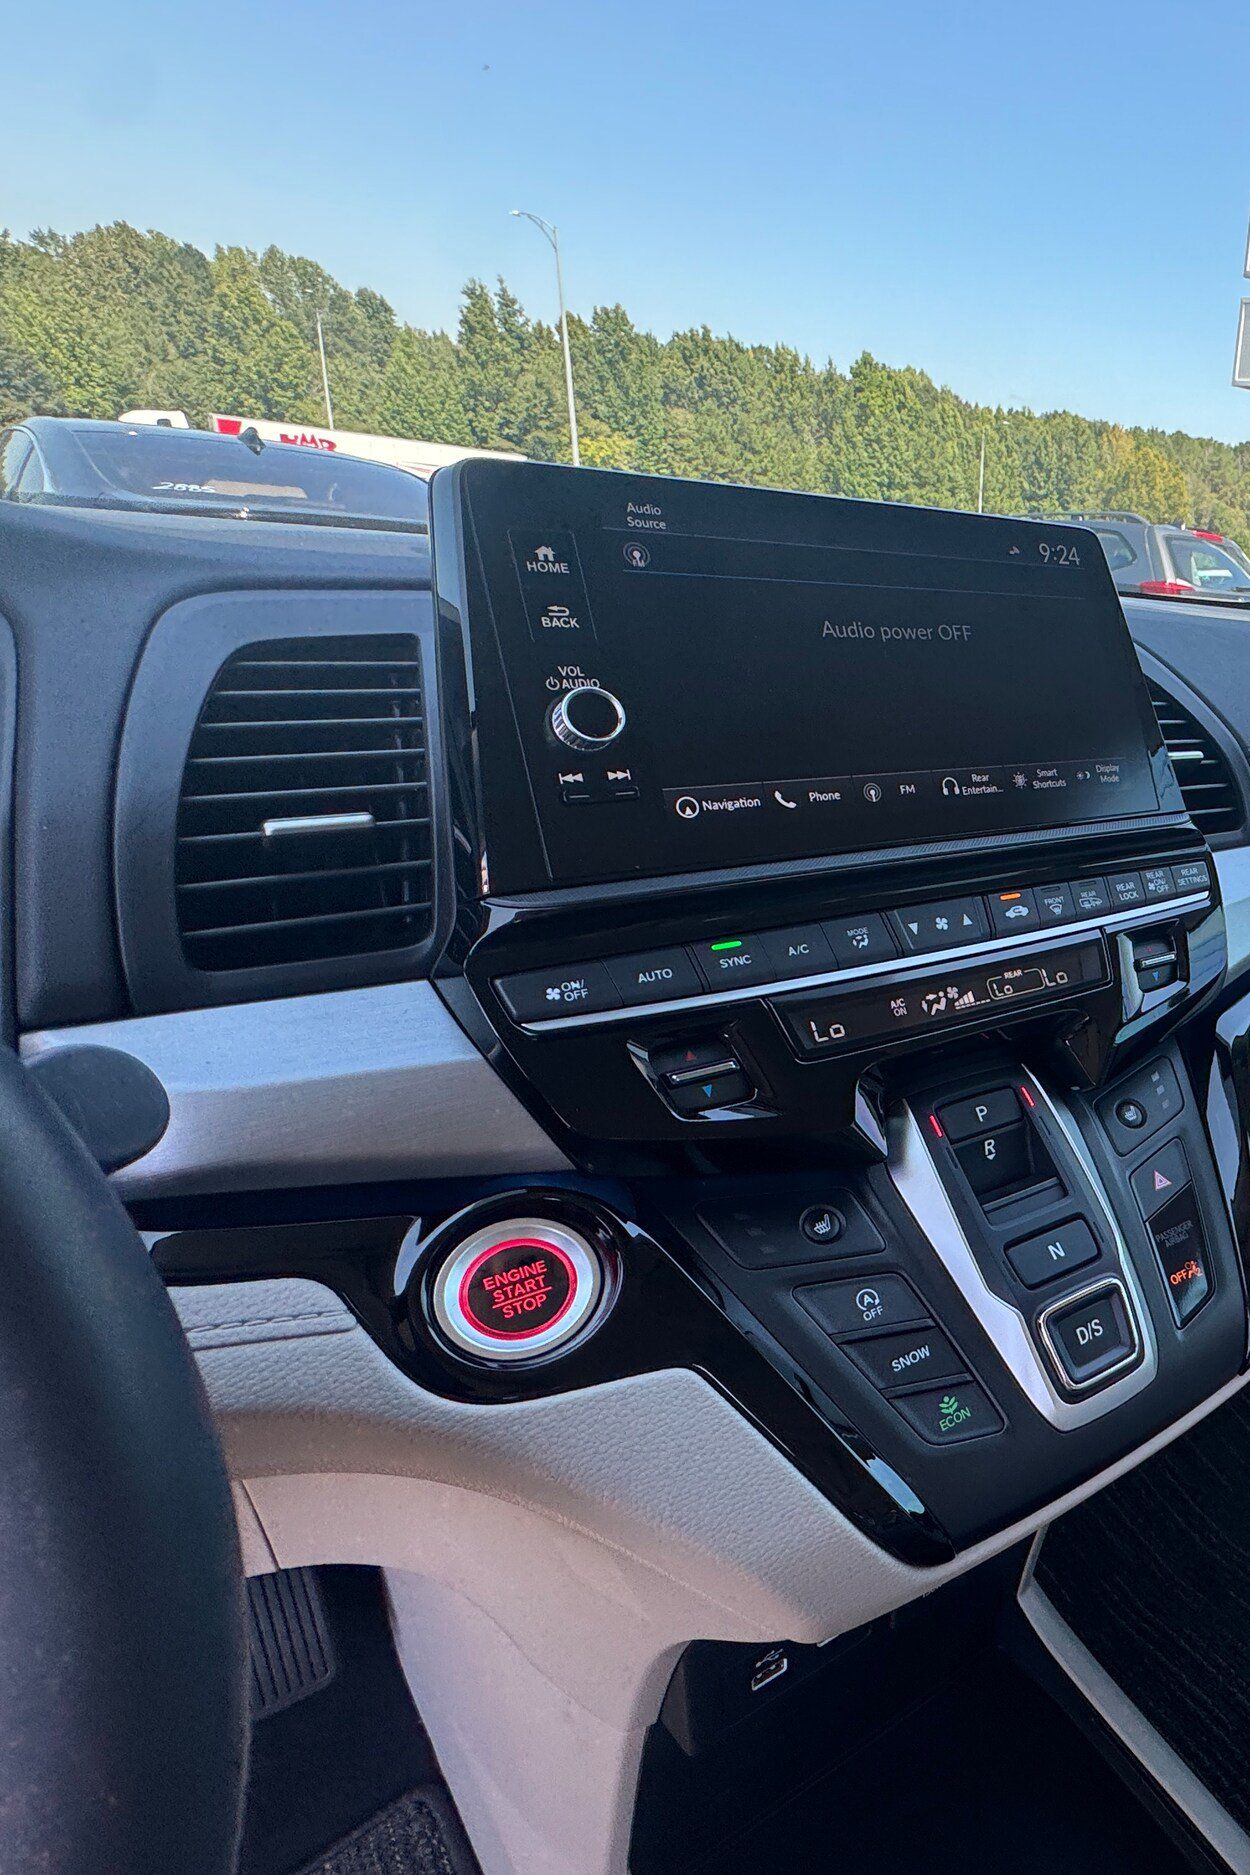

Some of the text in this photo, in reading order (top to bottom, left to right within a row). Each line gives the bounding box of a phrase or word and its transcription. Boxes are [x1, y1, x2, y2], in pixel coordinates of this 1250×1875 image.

[627, 502, 662, 516] Audio
[627, 516, 667, 530] Source
[1038, 543, 1081, 565] 9:24
[526, 561, 570, 574] HOME
[541, 616, 580, 628] BACK
[822, 620, 972, 642] Audio power OFF
[558, 665, 585, 677] VOL
[562, 678, 601, 690] AUDIO
[1036, 768, 1058, 777] Smart
[1095, 764, 1119, 774] Display
[971, 773, 990, 782] Rear
[1032, 779, 1067, 789] Shortcuts
[1100, 774, 1120, 783] Mode
[899, 784, 916, 795] FM
[808, 791, 841, 802] Phone
[702, 797, 762, 812] Navigation
[1146, 870, 1164, 880] REAR
[1180, 867, 1199, 876] REAR
[1116, 881, 1135, 892] REAR
[1178, 875, 1208, 887] SETTINGS
[1080, 890, 1097, 898] REAR
[1157, 885, 1169, 893] OFF
[1044, 896, 1065, 906] FRONT
[1120, 891, 1139, 901] LOCK
[846, 926, 869, 937] MODE
[788, 943, 810, 957] A/C
[719, 954, 752, 969] SYNC
[637, 968, 673, 984] AUTO
[1003, 969, 1023, 980] REAR
[1041, 968, 1068, 987] Lo
[564, 988, 589, 1002] OFF
[890, 998, 906, 1009] A/C
[893, 1007, 908, 1017] ON
[810, 1020, 846, 1044] Lo
[975, 1105, 988, 1122] P
[984, 1139, 996, 1156] R
[1047, 1242, 1066, 1260] N
[482, 1260, 548, 1290] ENGINE
[1170, 1268, 1187, 1285] OFF
[492, 1275, 546, 1302] START
[502, 1293, 547, 1319] STOP
[863, 1305, 883, 1321] OFF
[1075, 1318, 1104, 1346] D/S
[891, 1345, 931, 1373] SNOW
[939, 1406, 972, 1432] ECON
